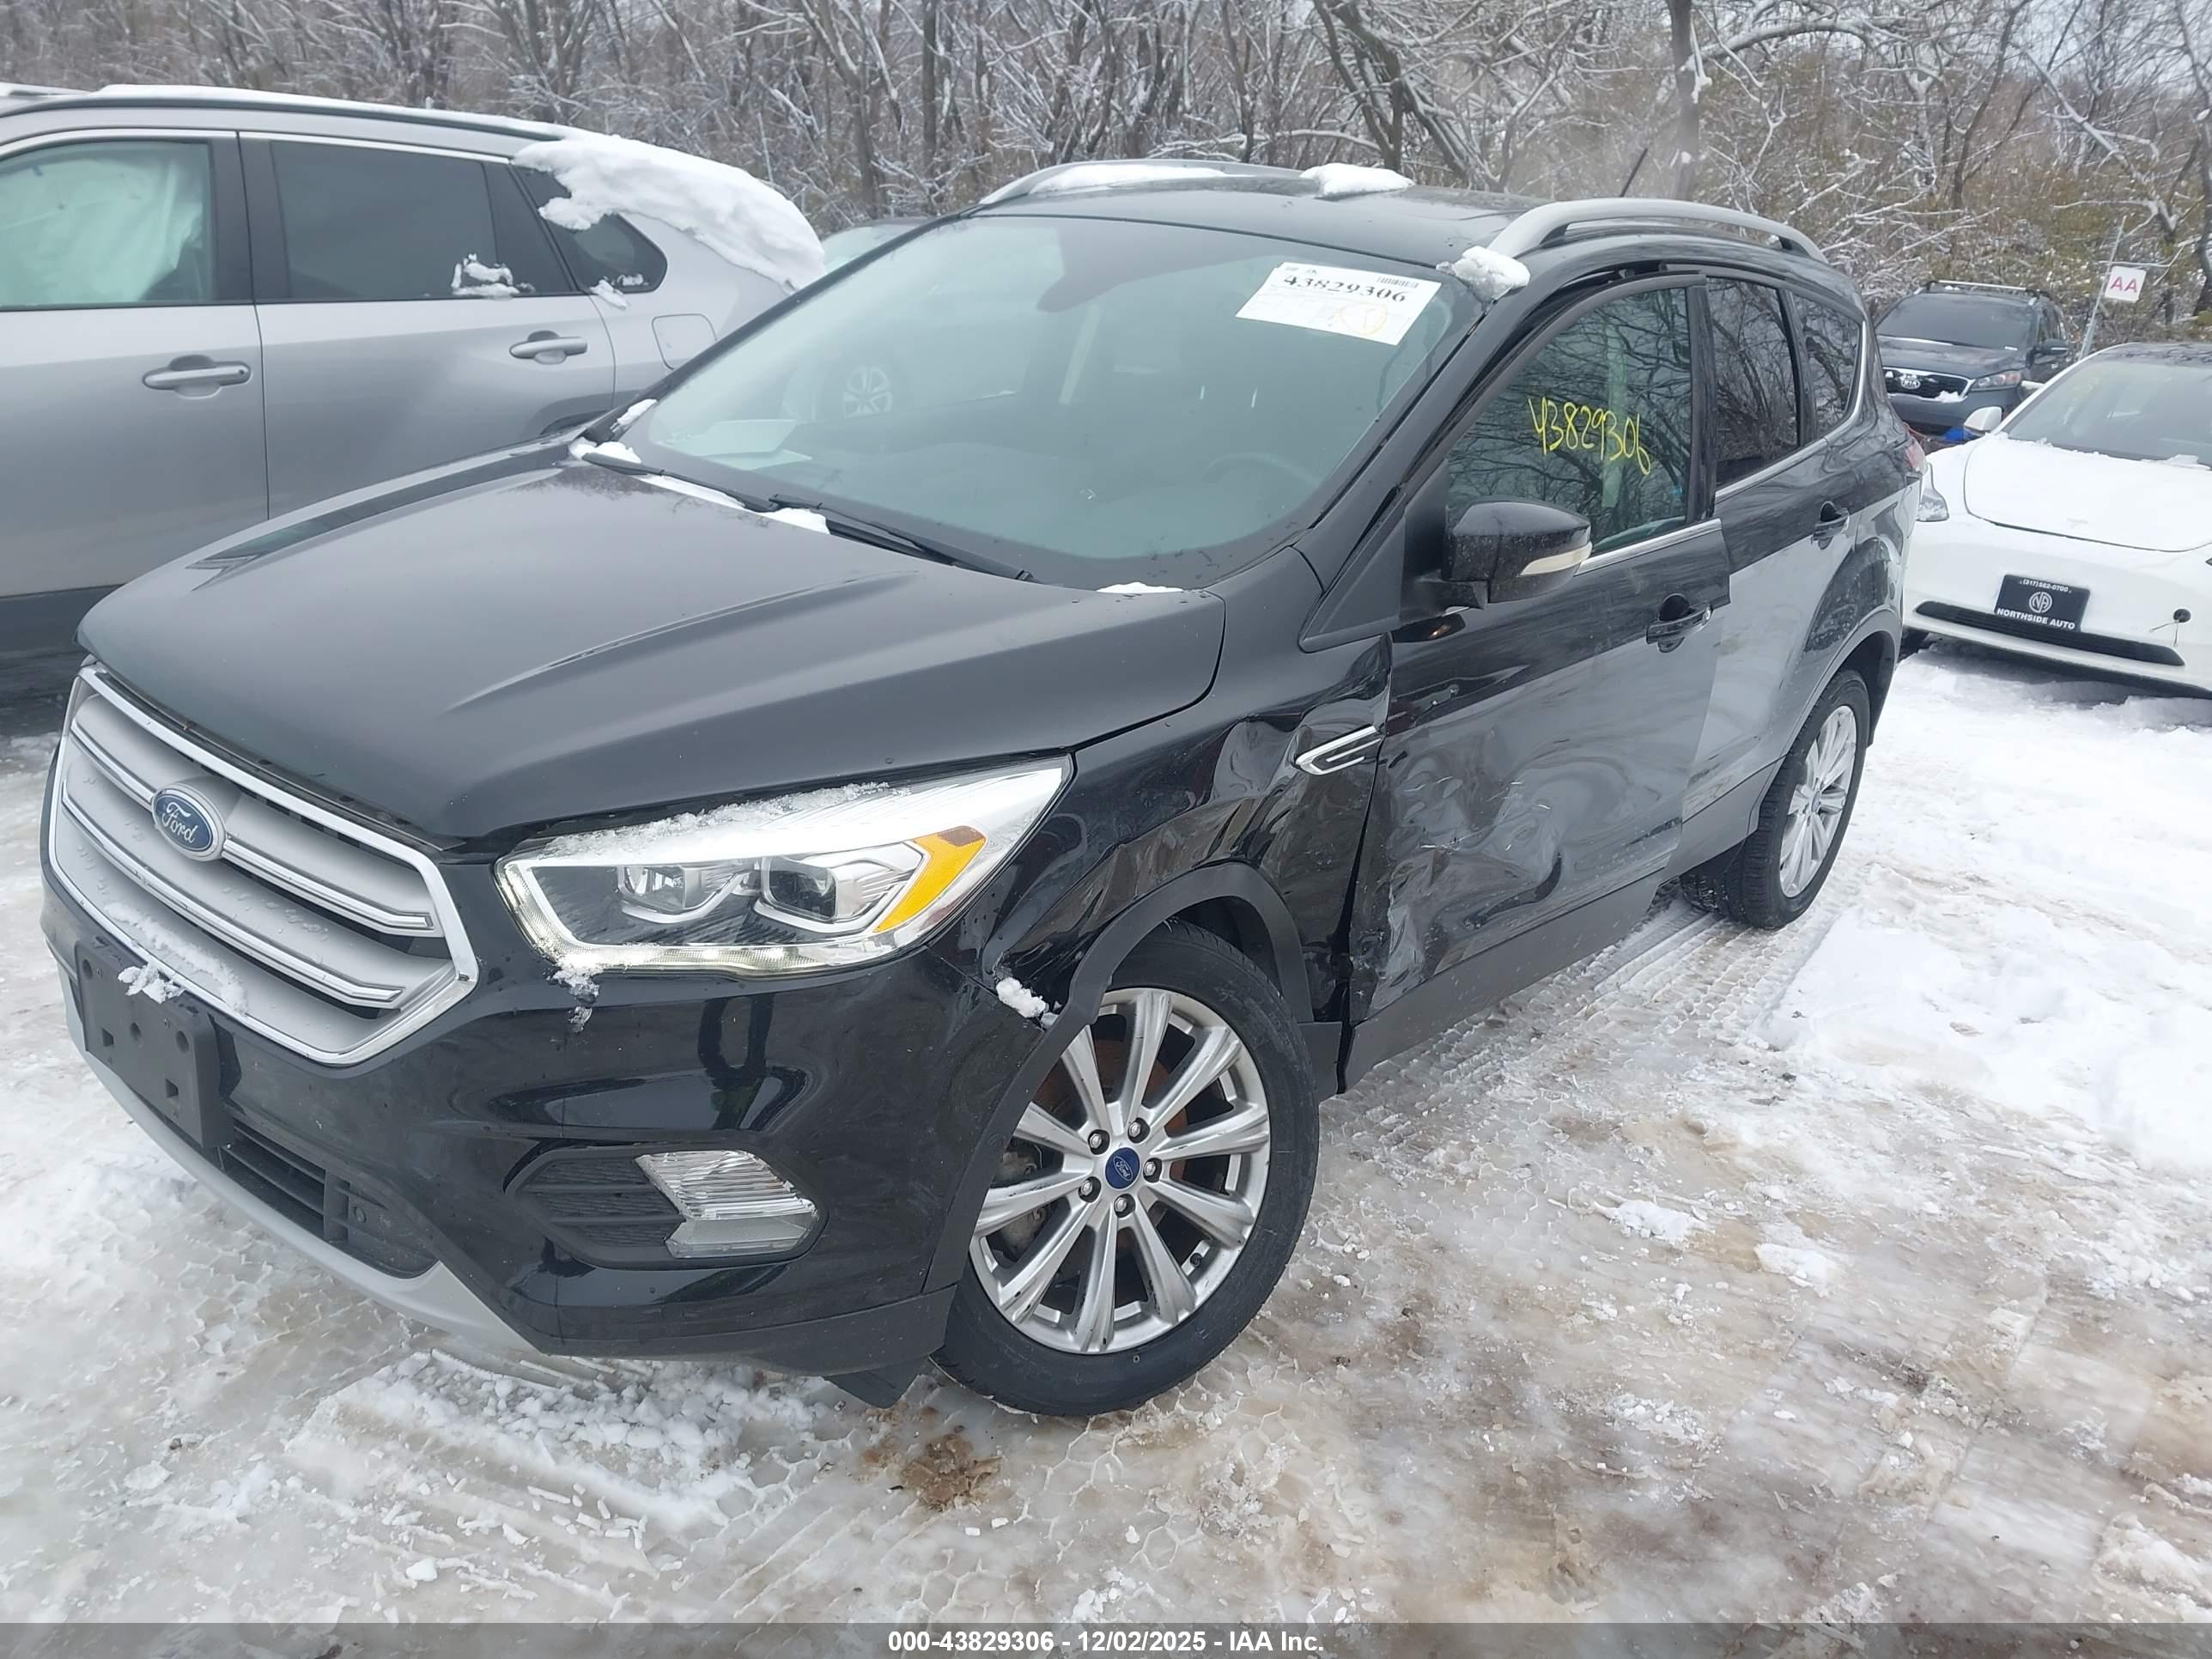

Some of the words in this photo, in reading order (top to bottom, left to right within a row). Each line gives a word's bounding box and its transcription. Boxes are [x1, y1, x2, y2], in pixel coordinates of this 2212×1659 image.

[1283, 274, 1407, 302] 43829306
[2110, 276, 2137, 293] AA
[1528, 396, 1651, 476] 43829306
[1996, 608, 2049, 624] NORTHSIDE
[2049, 618, 2075, 630] AUTO
[161, 801, 198, 843] Ford
[1115, 1160, 1131, 1177] Ford
